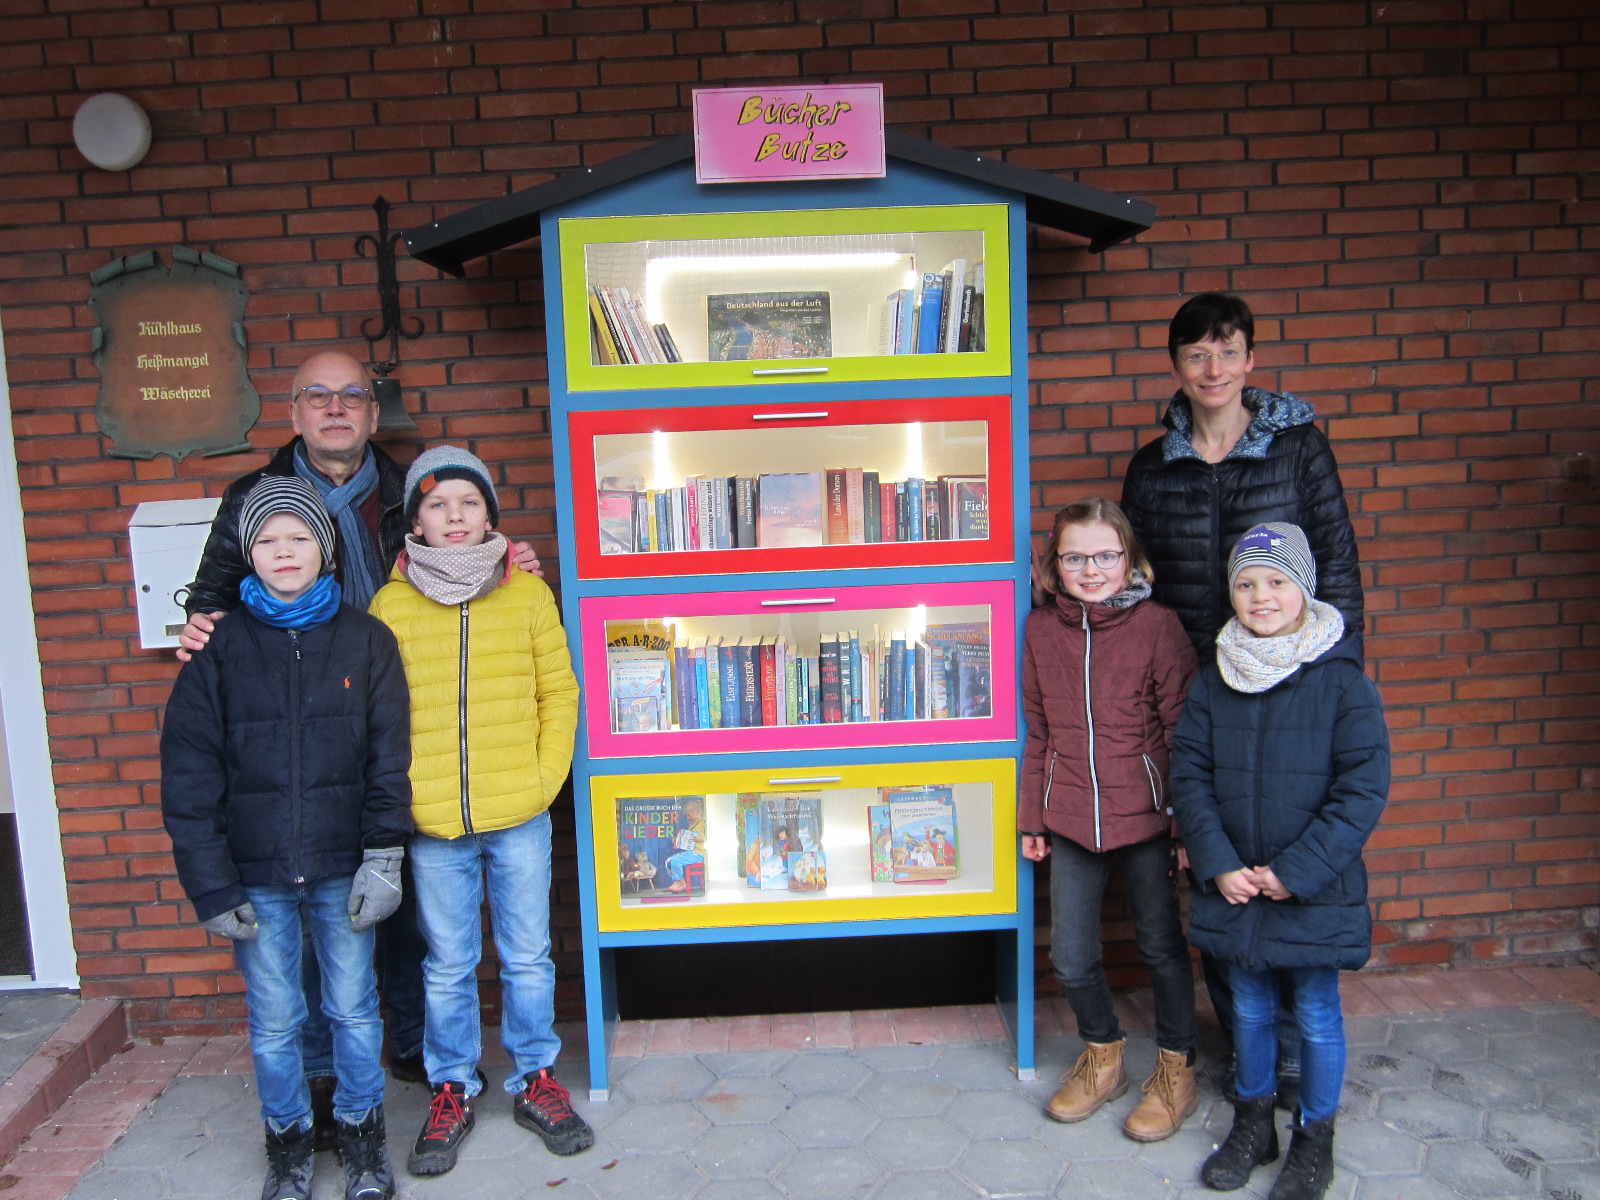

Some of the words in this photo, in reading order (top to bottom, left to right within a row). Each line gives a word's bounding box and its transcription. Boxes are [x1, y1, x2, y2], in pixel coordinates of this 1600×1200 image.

[737, 92, 852, 129] Bücher
[754, 131, 848, 163] Butze
[726, 300, 773, 309] Deutschland
[791, 299, 803, 307] der
[806, 299, 822, 307] Luft
[138, 321, 202, 337] Kühlhaus
[137, 352, 209, 371] Heißmangel
[140, 385, 211, 401] Wäscherei
[625, 812, 679, 825] KINDER
[625, 826, 675, 839] LIEDER
